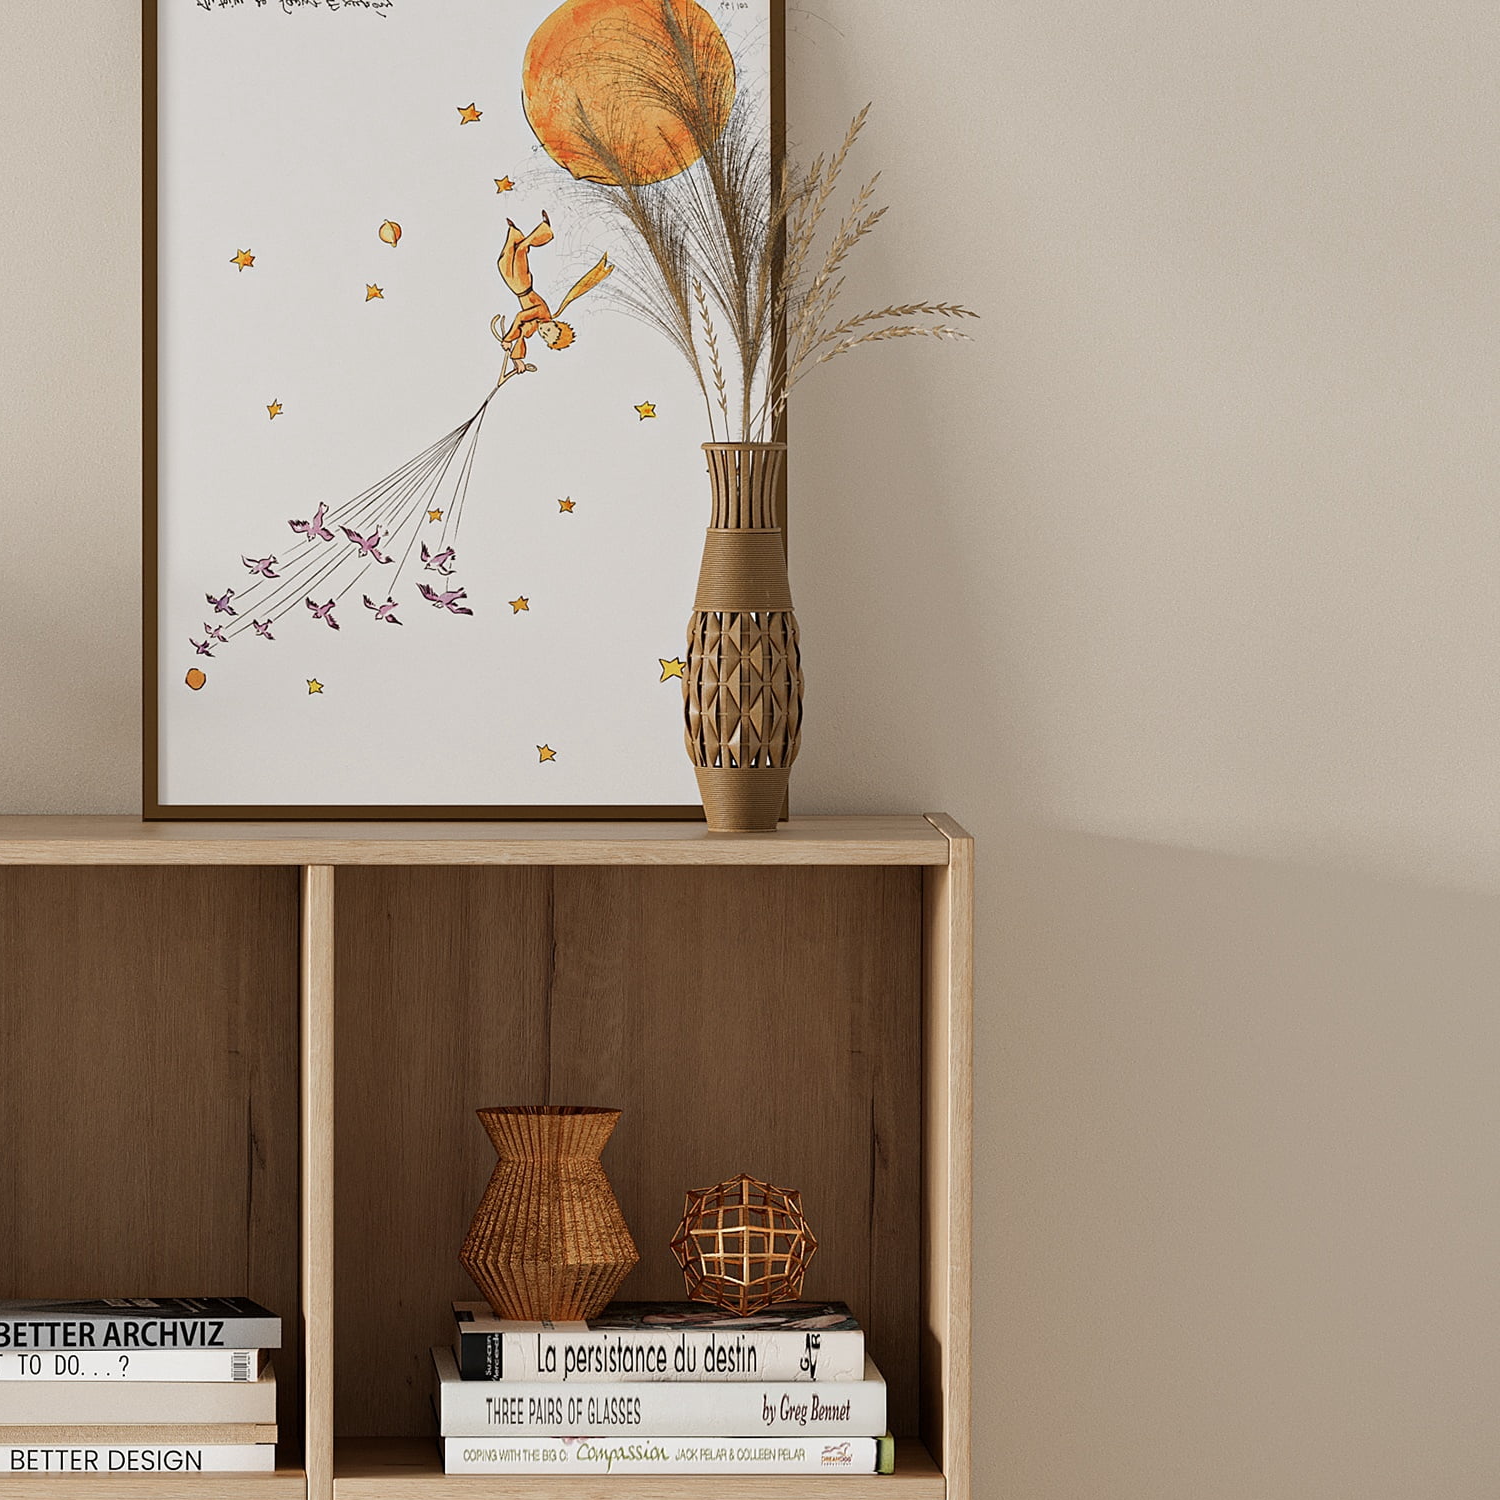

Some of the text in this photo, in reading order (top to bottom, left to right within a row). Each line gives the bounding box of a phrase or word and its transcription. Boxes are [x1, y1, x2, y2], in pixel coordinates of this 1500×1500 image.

[103, 1321, 225, 1348] ARCHVIZ
[17, 1354, 41, 1375] TO
[538, 1333, 756, 1376] La persistance du destin
[486, 1397, 640, 1424] THREE PAIRS OF GLASSES
[762, 1393, 851, 1426] by Greg Bennet
[11, 1450, 201, 1472] BETTER DESIGN
[576, 1440, 670, 1474] Compassion
[675, 1448, 806, 1463] JACK PELAR & COLLEEN PELAR
